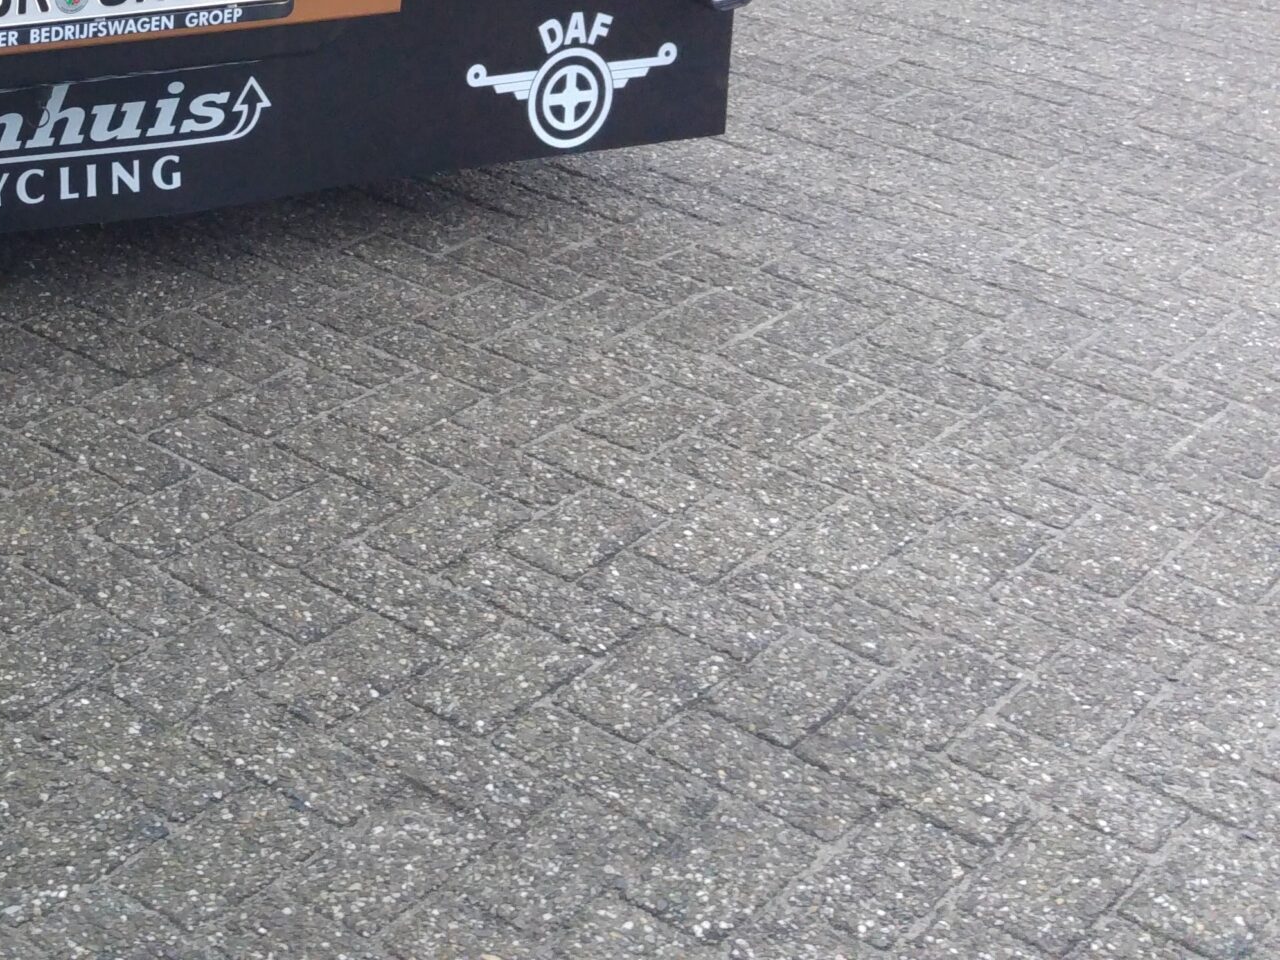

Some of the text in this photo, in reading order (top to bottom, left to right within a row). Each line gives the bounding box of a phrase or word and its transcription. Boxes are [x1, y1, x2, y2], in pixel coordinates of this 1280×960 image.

[29, 14, 174, 46] BEDRIJFSWAGEN
[184, 7, 243, 28] GROEP
[537, 11, 614, 54] DAF
